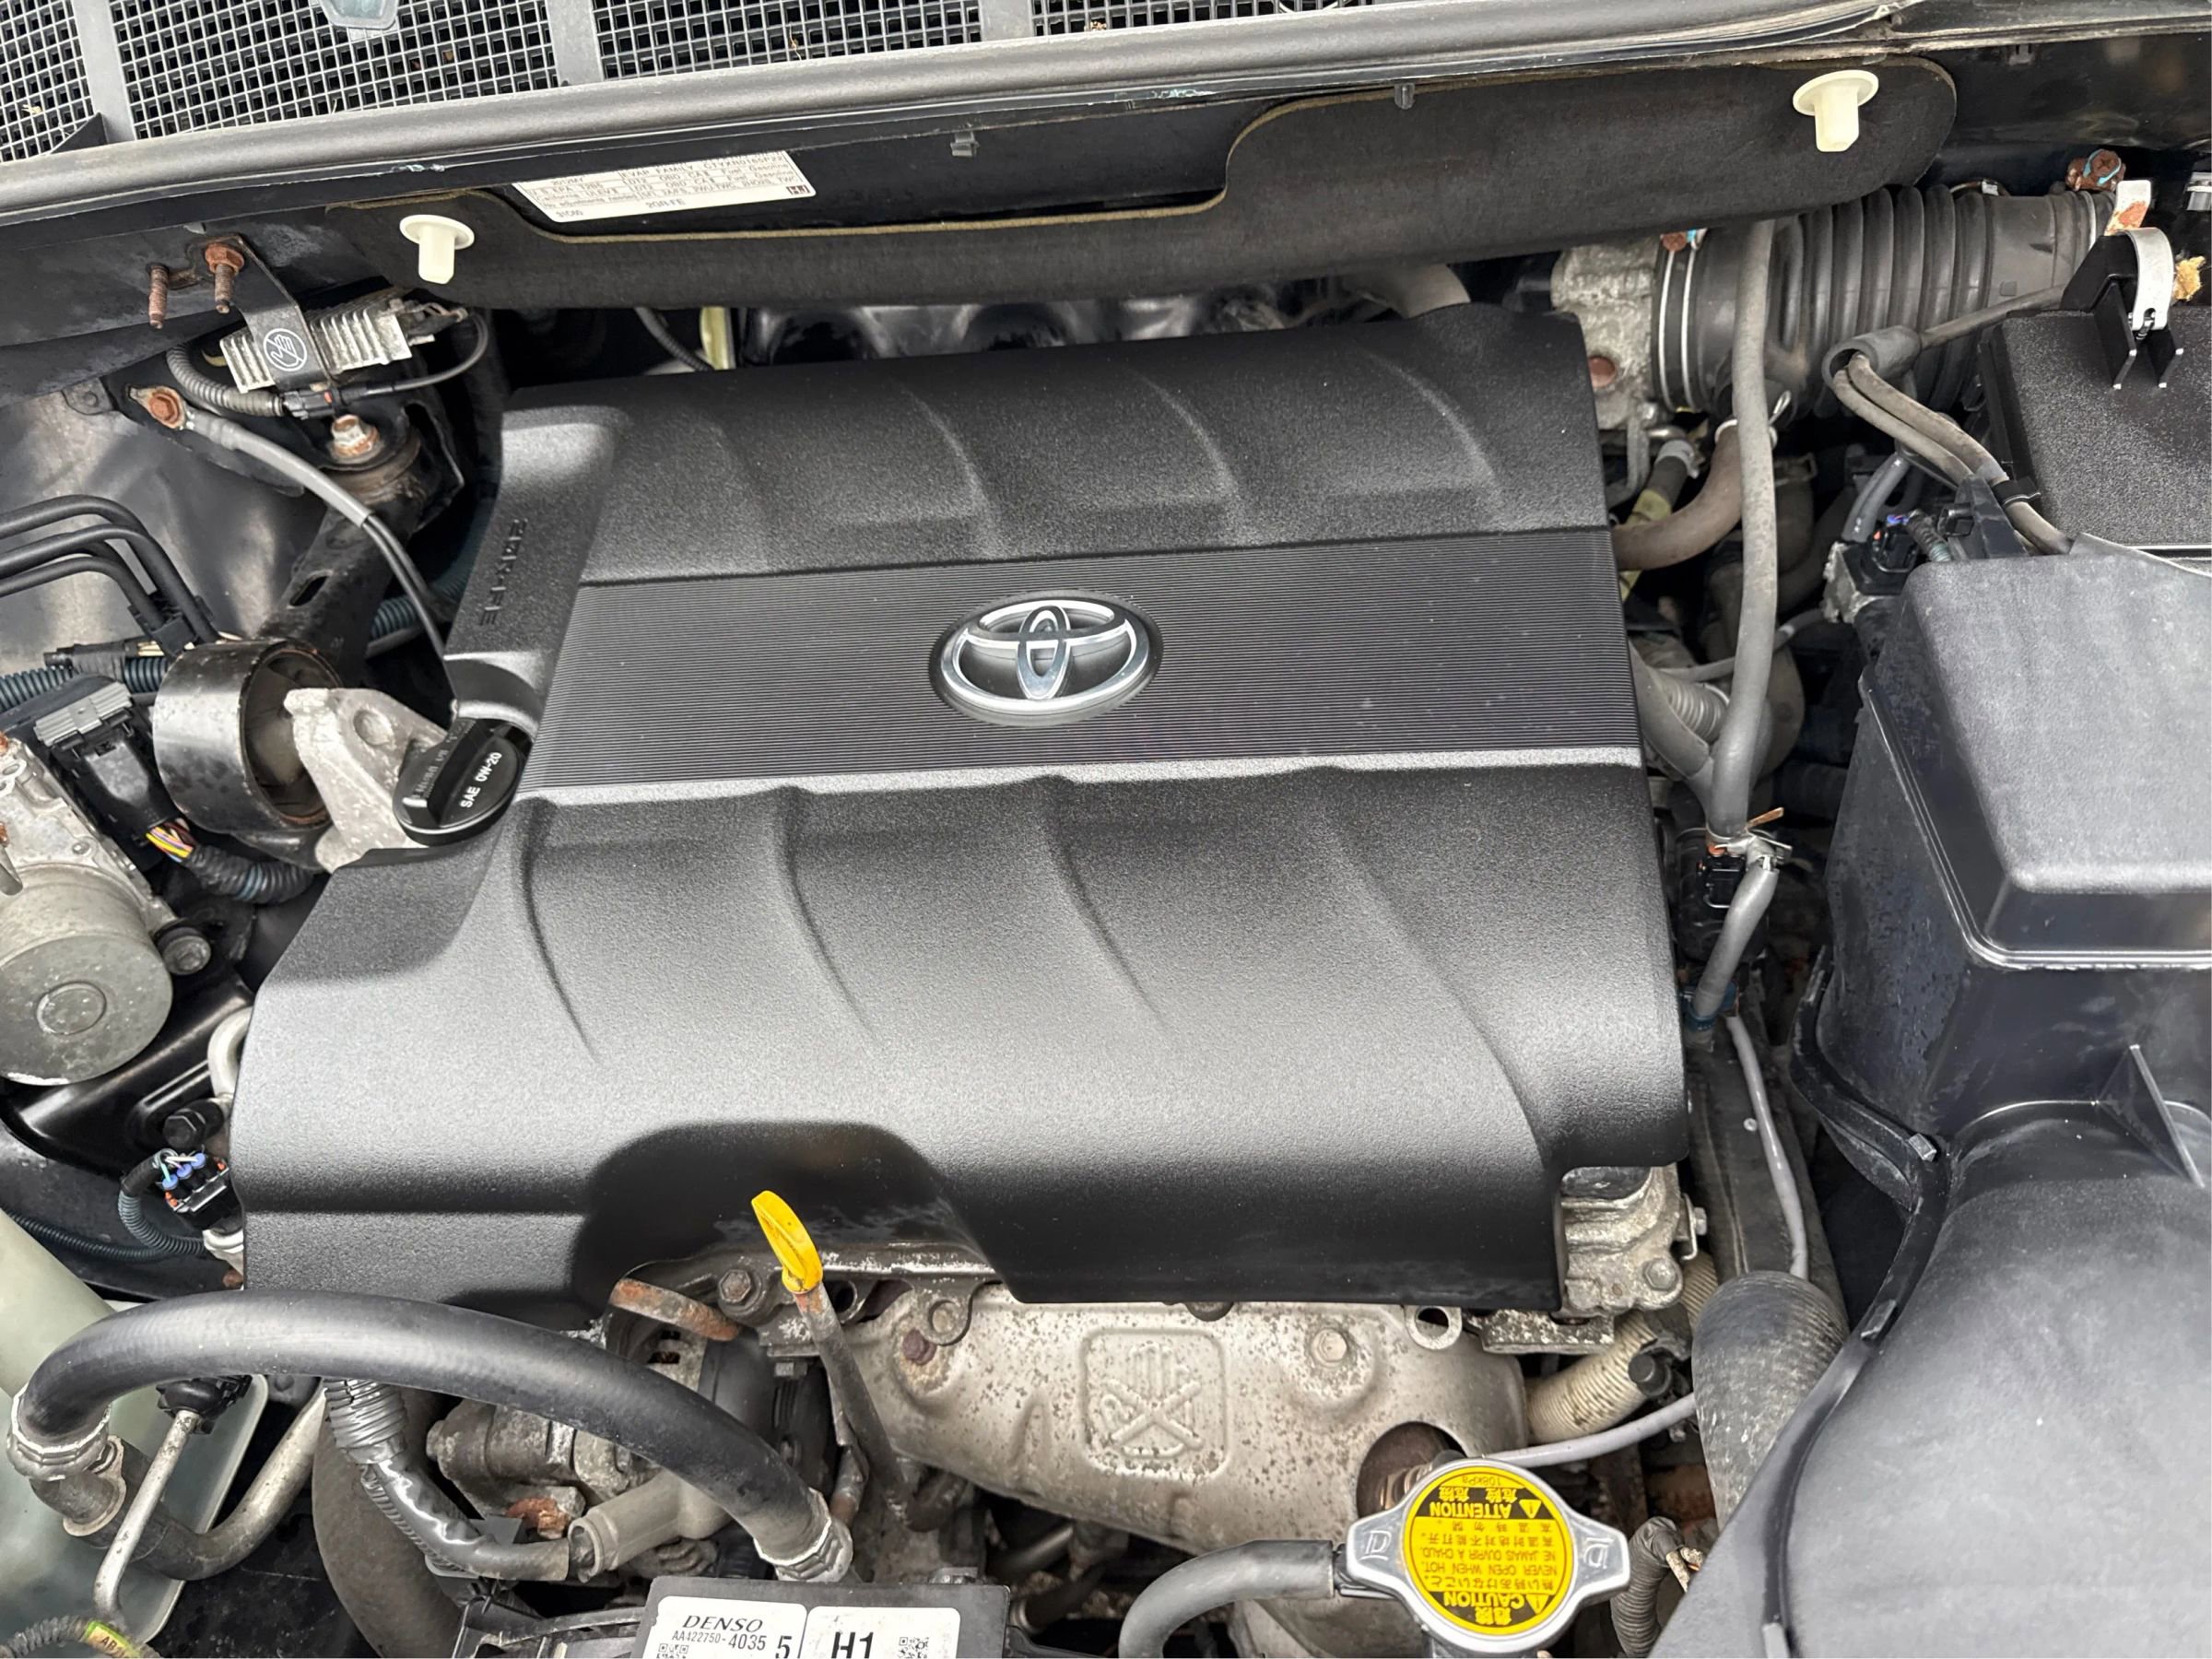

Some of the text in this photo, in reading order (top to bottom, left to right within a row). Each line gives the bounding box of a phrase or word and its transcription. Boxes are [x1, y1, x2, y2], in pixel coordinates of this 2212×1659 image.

[656, 165, 693, 174] FAMILY
[460, 751, 502, 809] SAE 0W-20
[1461, 1475, 1501, 1487] 108kPa
[1429, 1500, 1512, 1519] ATTENTION
[1468, 1548, 1502, 1560] OUVRIR
[1506, 1549, 1538, 1561] JAMAIS
[1544, 1550, 1556, 1561] NE
[1424, 1561, 1558, 1575] NEVER OPEN WHEN HOT.
[1443, 1592, 1526, 1608] CAUTION
[682, 1614, 763, 1633] DENSO
[830, 1630, 875, 1658] H1
